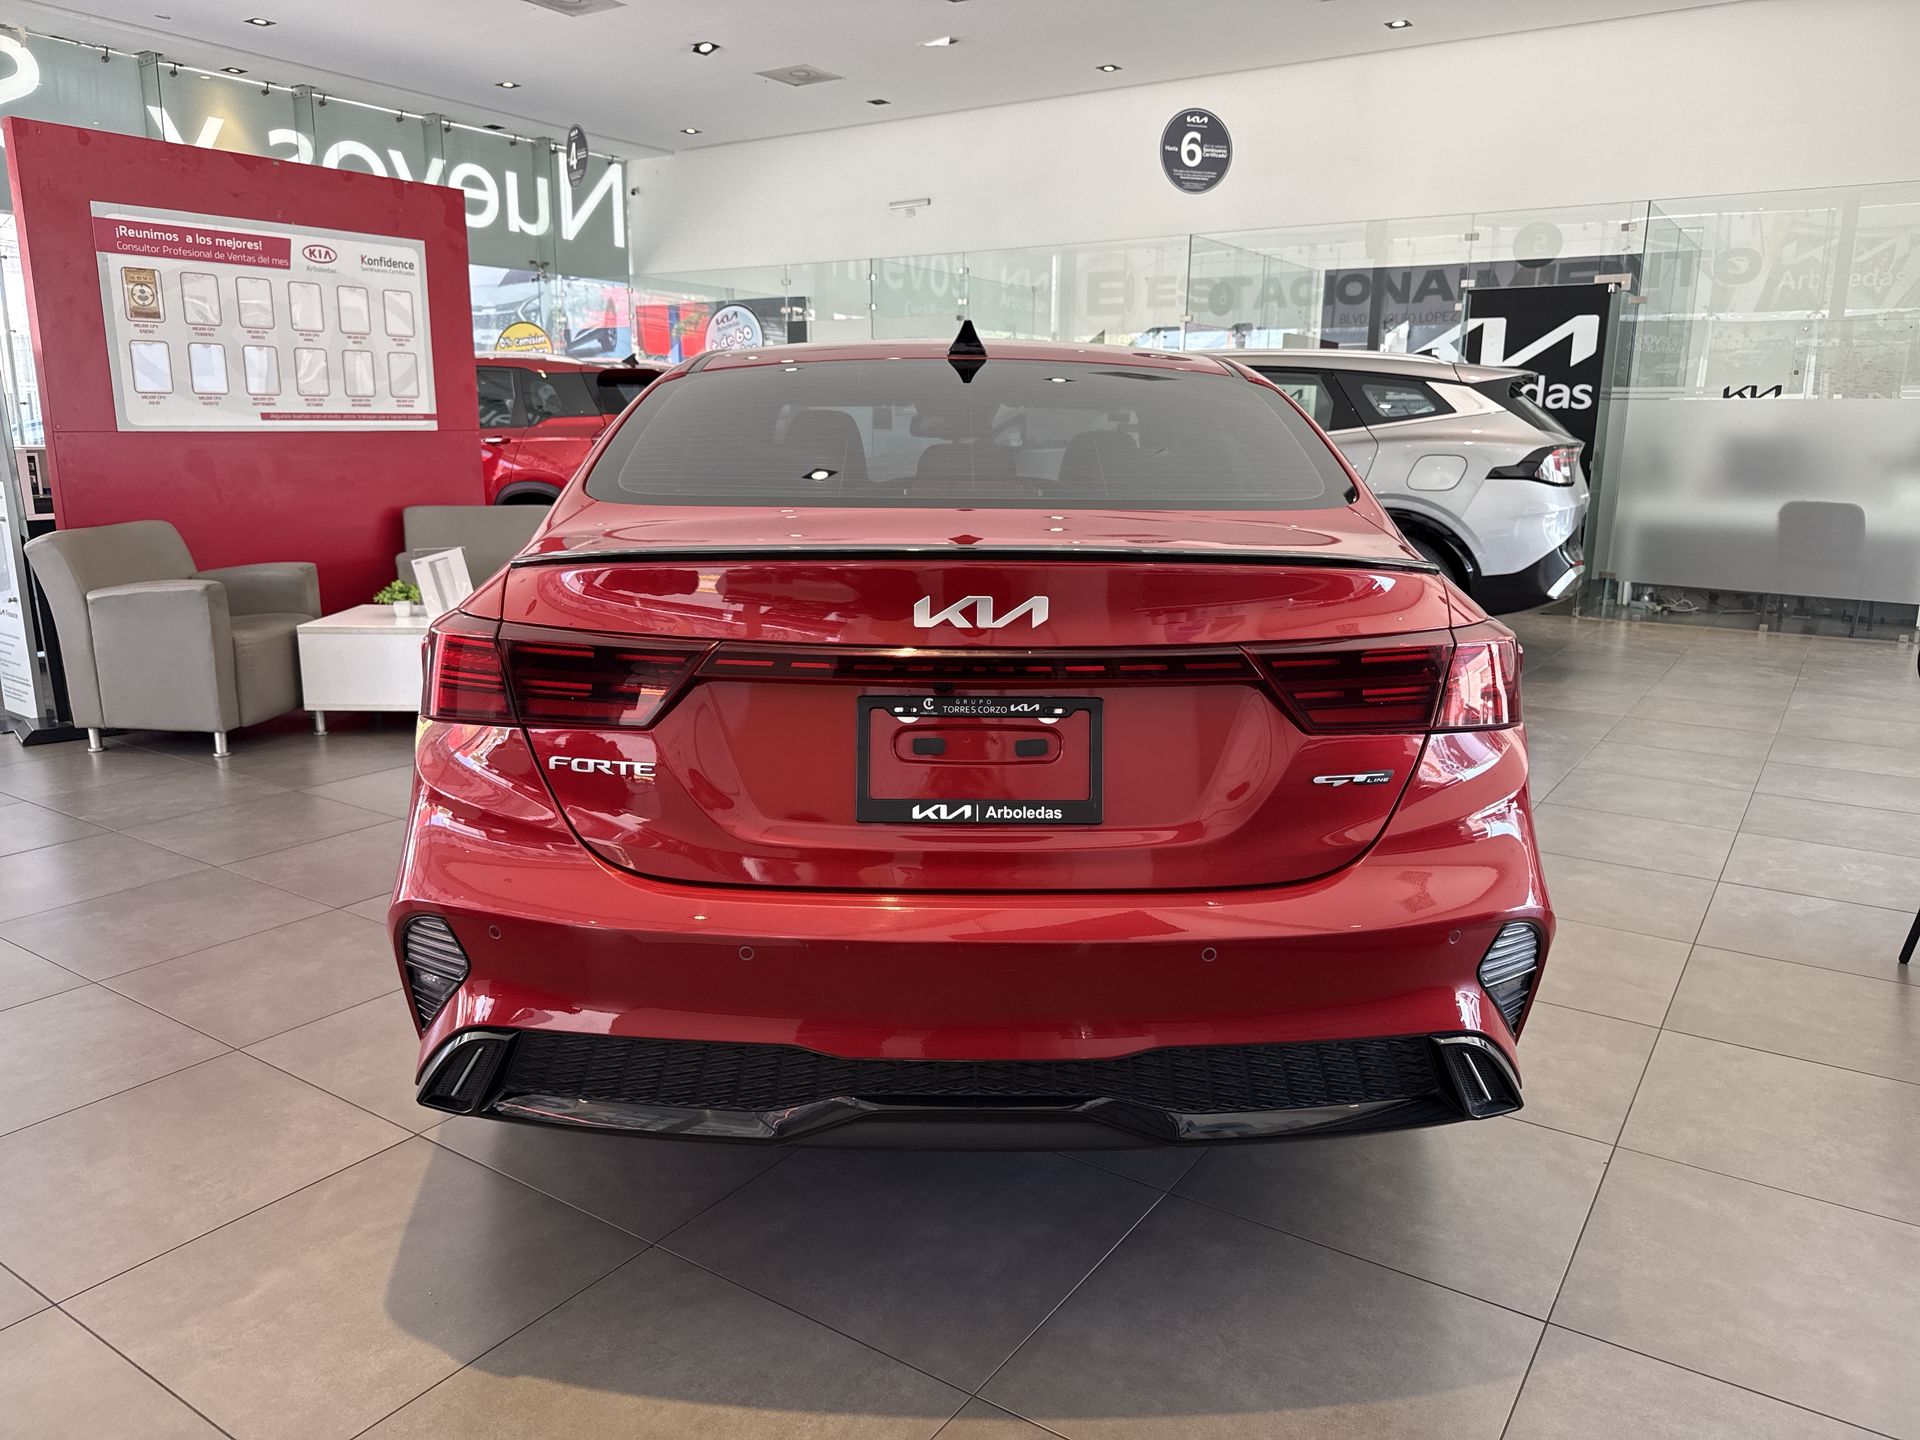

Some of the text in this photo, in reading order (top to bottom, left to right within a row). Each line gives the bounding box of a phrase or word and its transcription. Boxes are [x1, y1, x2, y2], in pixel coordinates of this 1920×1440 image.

[569, 142, 578, 170] 4
[1180, 131, 1202, 168] 6
[115, 225, 263, 251] ¡Reunimos a los mejores!
[116, 240, 289, 266] Consultor Profesional de Ventas del mes
[308, 248, 333, 260] KIA
[360, 255, 415, 270] Konfidence
[306, 264, 338, 274] Arboledas
[1777, 265, 1907, 291] Arboedas
[716, 311, 739, 326] KIA
[720, 334, 735, 348] de
[736, 325, 754, 344] 60
[1722, 384, 1783, 398] KIA
[913, 595, 1049, 629] KIA
[942, 706, 976, 714] TORRES
[977, 706, 1008, 714] CORZO
[1010, 703, 1040, 712] KIA
[548, 755, 657, 777] FORTE
[1313, 772, 1385, 787] GT
[912, 804, 1063, 820] KIA Arboledas
